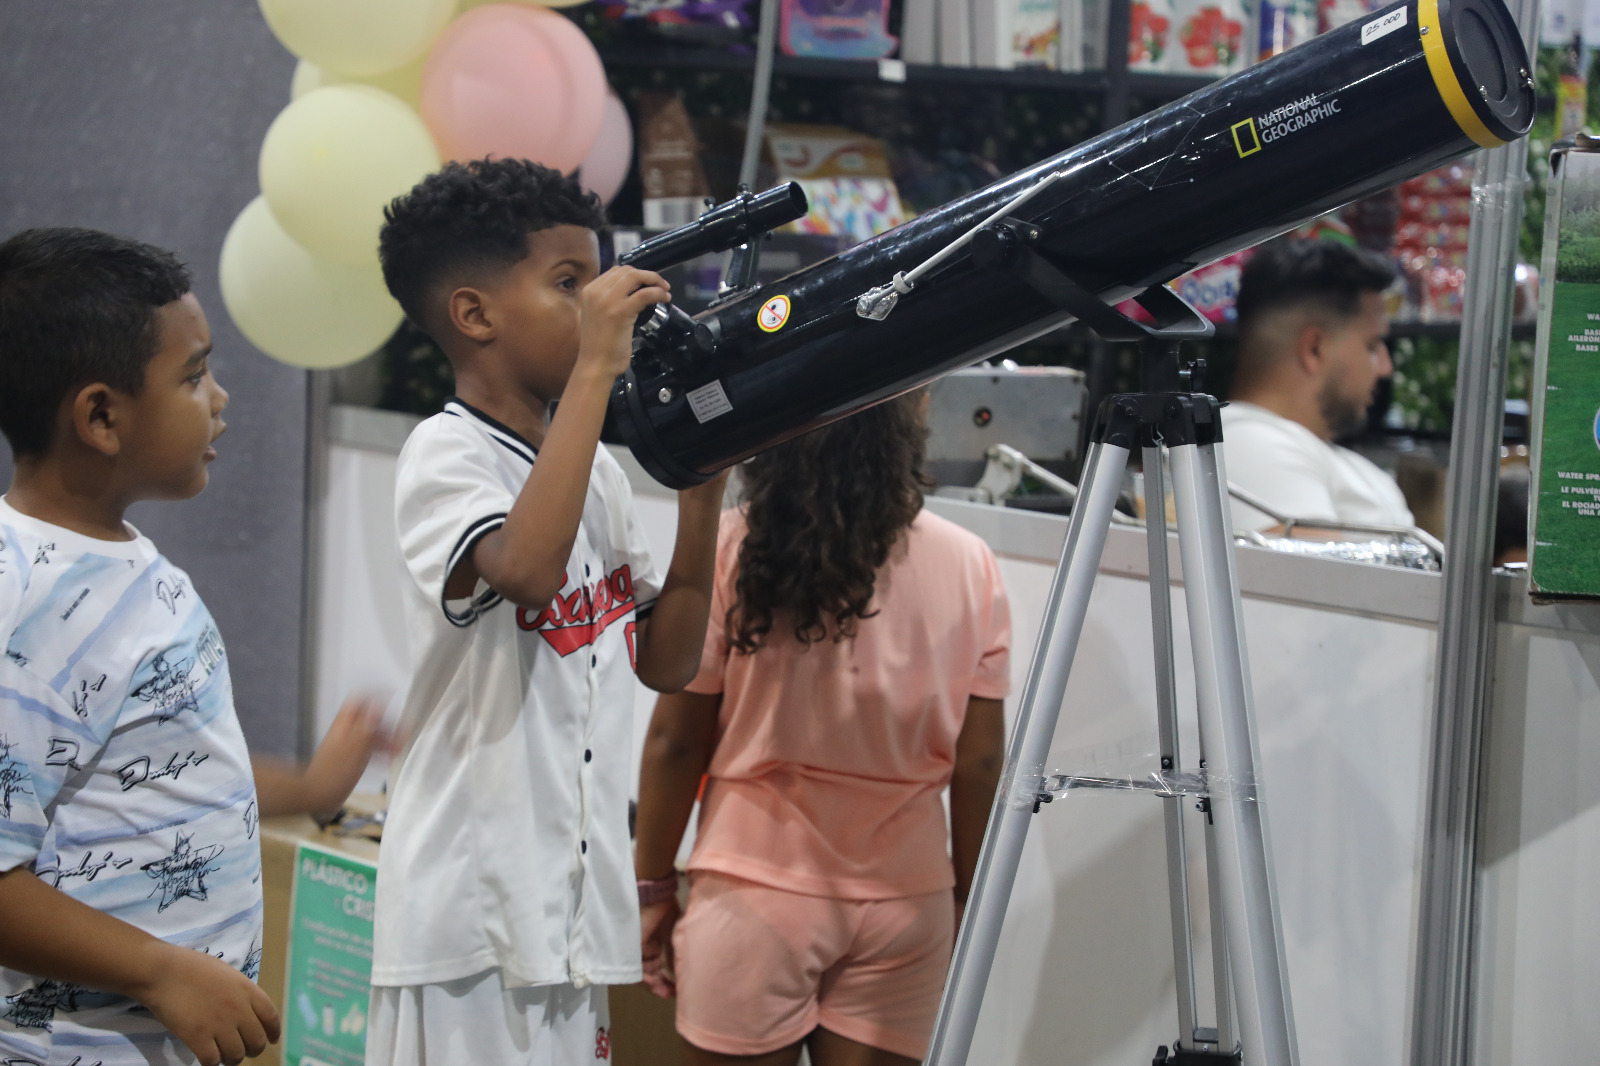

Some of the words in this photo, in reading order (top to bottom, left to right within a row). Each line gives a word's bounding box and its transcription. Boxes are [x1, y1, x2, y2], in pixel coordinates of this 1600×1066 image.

[1365, 22, 1380, 37] 25
[1257, 93, 1320, 129] NATIONAL
[1262, 99, 1341, 143] GEOGRAPHIC
[1576, 344, 1599, 352] BASES
[1557, 471, 1584, 480] WATER
[1562, 500, 1570, 508] EL
[1578, 508, 1595, 516] UNA
